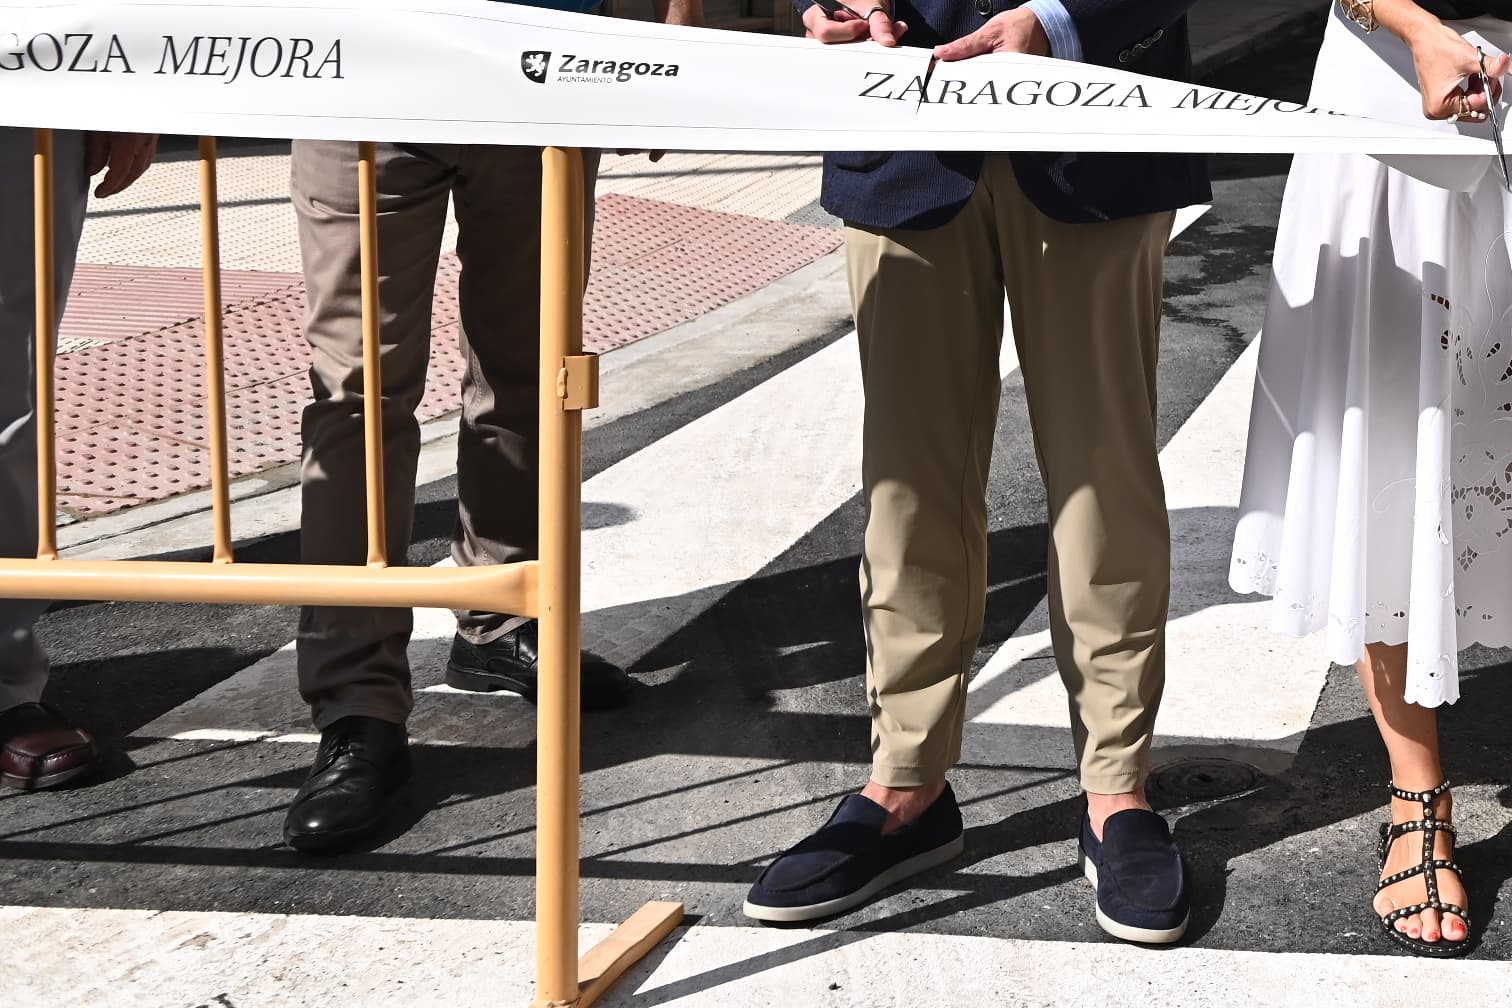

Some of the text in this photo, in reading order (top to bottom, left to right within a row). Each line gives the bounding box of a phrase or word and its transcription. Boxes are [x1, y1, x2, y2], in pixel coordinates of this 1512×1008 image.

[153, 35, 344, 84] MEJORA
[558, 54, 680, 82] Zaragoza
[557, 75, 613, 84] AYUNTAMIENTO
[857, 71, 1373, 119] ZARAGOZA MEJO
